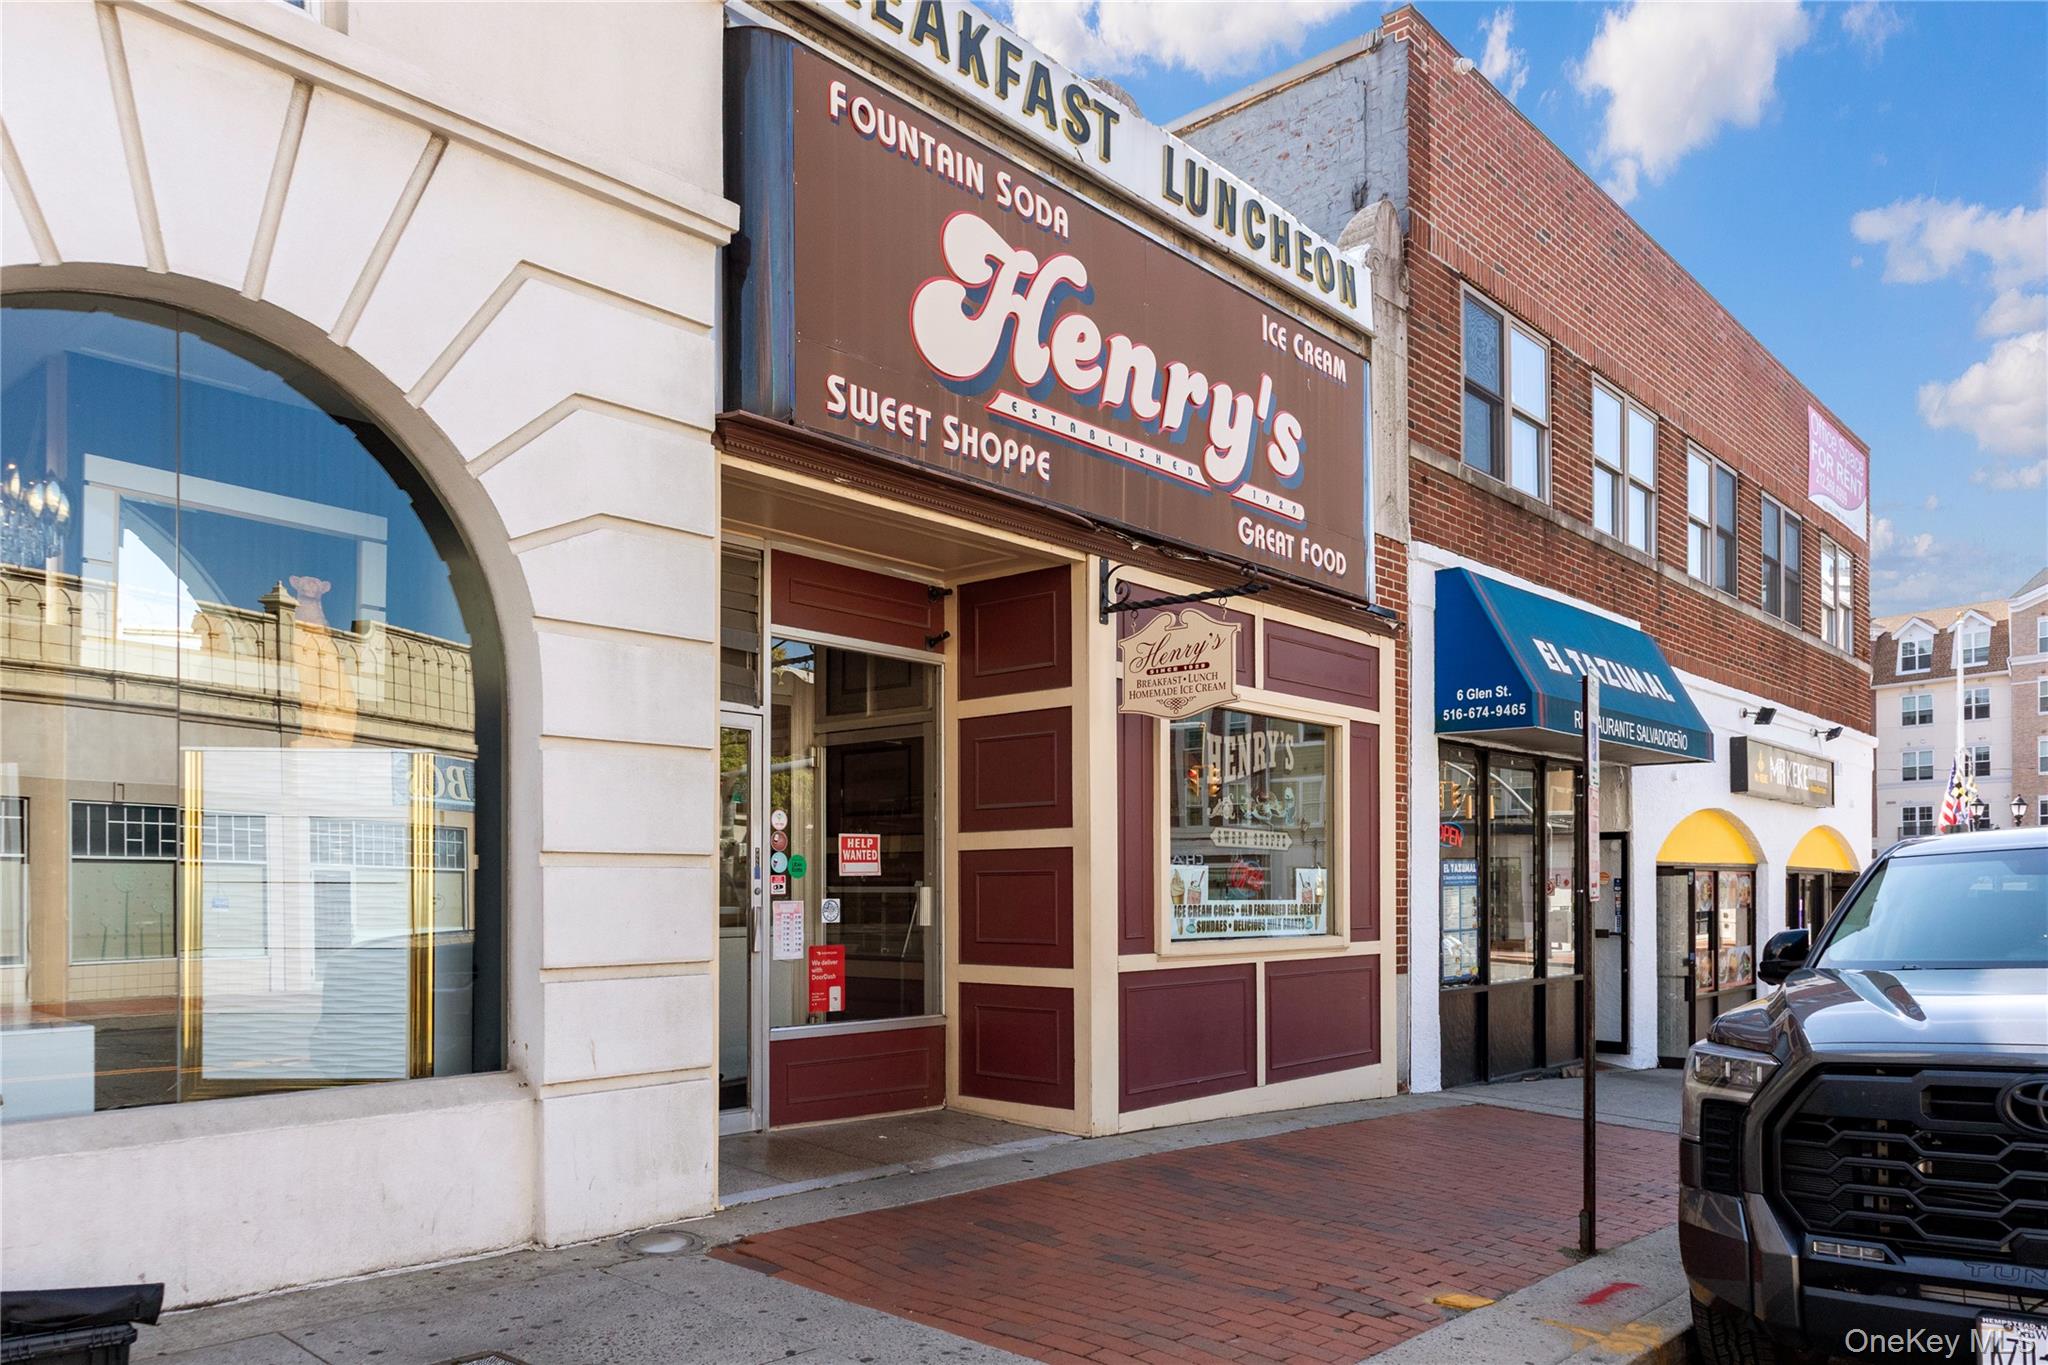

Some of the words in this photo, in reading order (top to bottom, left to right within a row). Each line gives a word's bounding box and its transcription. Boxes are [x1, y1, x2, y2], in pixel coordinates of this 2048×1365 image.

[829, 80, 985, 194] FOUNTAIN
[996, 170, 1069, 239] SODA
[846, 0, 1121, 164] AKFAST
[1161, 143, 1359, 309] LUNCHEON
[910, 210, 1304, 487] Henry's
[1261, 314, 1288, 349] ICE
[1293, 332, 1347, 384] CREAM
[825, 374, 930, 443] SWEET
[942, 415, 1051, 483] SHOPPE
[1011, 401, 1194, 476] ESTABLISHED
[1252, 489, 1297, 514] 1929
[1810, 441, 1834, 476] FOR
[1836, 461, 1863, 500] RENT
[1238, 516, 1295, 559] GREAT
[1301, 537, 1347, 575] FOOD
[1129, 632, 1226, 674] Henry's
[1149, 666, 1178, 675] SINCE
[1532, 638, 1573, 675] EL
[1564, 648, 1676, 703] TAZUMAL
[1129, 686, 1177, 700] HOMEMADE
[1180, 684, 1194, 695] ICE
[1195, 681, 1226, 693] CREAM
[1136, 675, 1182, 689] BREAKFAST
[1188, 671, 1218, 683] LUNCH
[1456, 689, 1464, 701] 6
[1466, 687, 1493, 700] Glen
[1495, 685, 1512, 697] St.
[1443, 702, 1527, 721] 516-674-9465
[1574, 710, 1635, 740] RAURANTE
[1636, 725, 1688, 751] SALVADOREÑO
[1206, 730, 1295, 785] HENRY'S
[842, 849, 878, 862] WANTED
[846, 837, 874, 849] HELP
[1174, 905, 1186, 918] ICE
[1187, 905, 1213, 918] CREAM
[1213, 904, 1236, 917] CONES
[1196, 919, 1228, 933] SUNDAES
[1233, 918, 1266, 932] DELICIOUS
